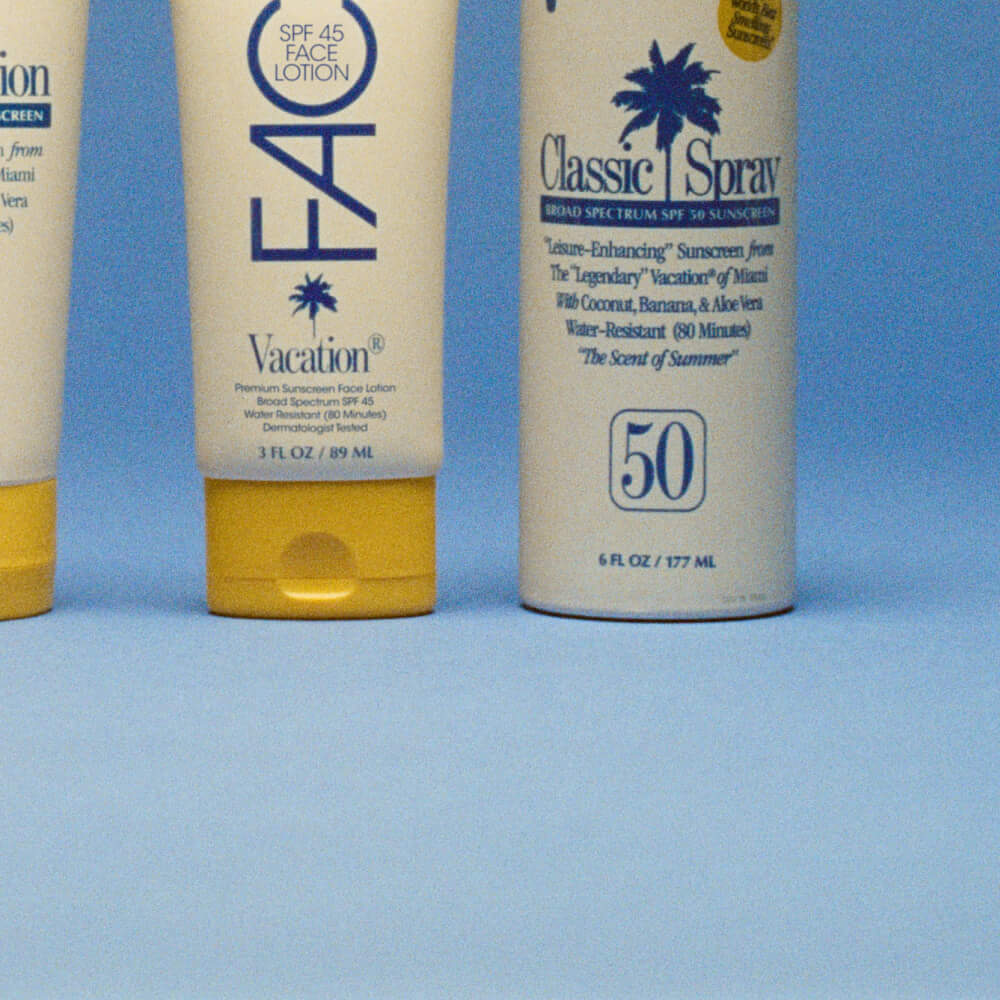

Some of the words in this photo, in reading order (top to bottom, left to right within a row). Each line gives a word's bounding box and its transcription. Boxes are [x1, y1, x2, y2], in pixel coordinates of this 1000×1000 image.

[280, 24, 313, 42] SPF
[319, 24, 344, 42] 45
[286, 43, 338, 62] FACE
[275, 63, 349, 82] LOTION
[7, 141, 43, 161] from
[540, 132, 653, 195] Classic
[686, 137, 781, 200] Spray
[0, 193, 28, 208] Vera
[545, 204, 581, 218] BROAD
[585, 206, 658, 221] SPECTRUM
[661, 209, 685, 221] SPF
[690, 209, 705, 221] 50
[709, 206, 776, 220] SUNSCREEN
[677, 242, 744, 260] Sunscreen
[745, 239, 774, 262] from
[550, 264, 568, 282] The
[717, 266, 734, 289] of
[733, 265, 769, 284] Miami
[556, 291, 579, 310] With
[581, 294, 637, 316] Coconut,
[639, 296, 697, 317] Banana,
[698, 297, 709, 313] &
[712, 295, 739, 312] Aloe
[739, 295, 764, 312] Vera
[565, 319, 666, 340] Water-Resistant
[672, 320, 696, 341] (80
[698, 320, 751, 340] Minutes)
[610, 349, 647, 368] Scent
[651, 349, 667, 371] of
[234, 383, 279, 393] Premium
[282, 383, 335, 393] Sunscreen
[338, 383, 363, 393] Face
[366, 383, 396, 393] Lotion
[257, 396, 287, 406] Broad
[290, 397, 340, 409] Spectrum
[342, 397, 359, 406] SPF
[361, 397, 374, 406] 45
[243, 409, 273, 419] Water
[275, 409, 321, 419] Resistant
[323, 409, 340, 421] (80
[343, 409, 387, 421] Minutes)
[263, 422, 335, 435] Dermatologist
[336, 422, 368, 433] Tested
[258, 446, 266, 459] 3
[271, 446, 286, 459] FL
[290, 446, 313, 459] OZ
[329, 445, 348, 459] 89
[352, 445, 374, 459] ML
[621, 421, 694, 500] 50
[598, 553, 607, 566] 6
[611, 553, 625, 567] FL
[629, 554, 652, 568] OZ
[666, 555, 690, 569] 177
[694, 555, 716, 569] ML
